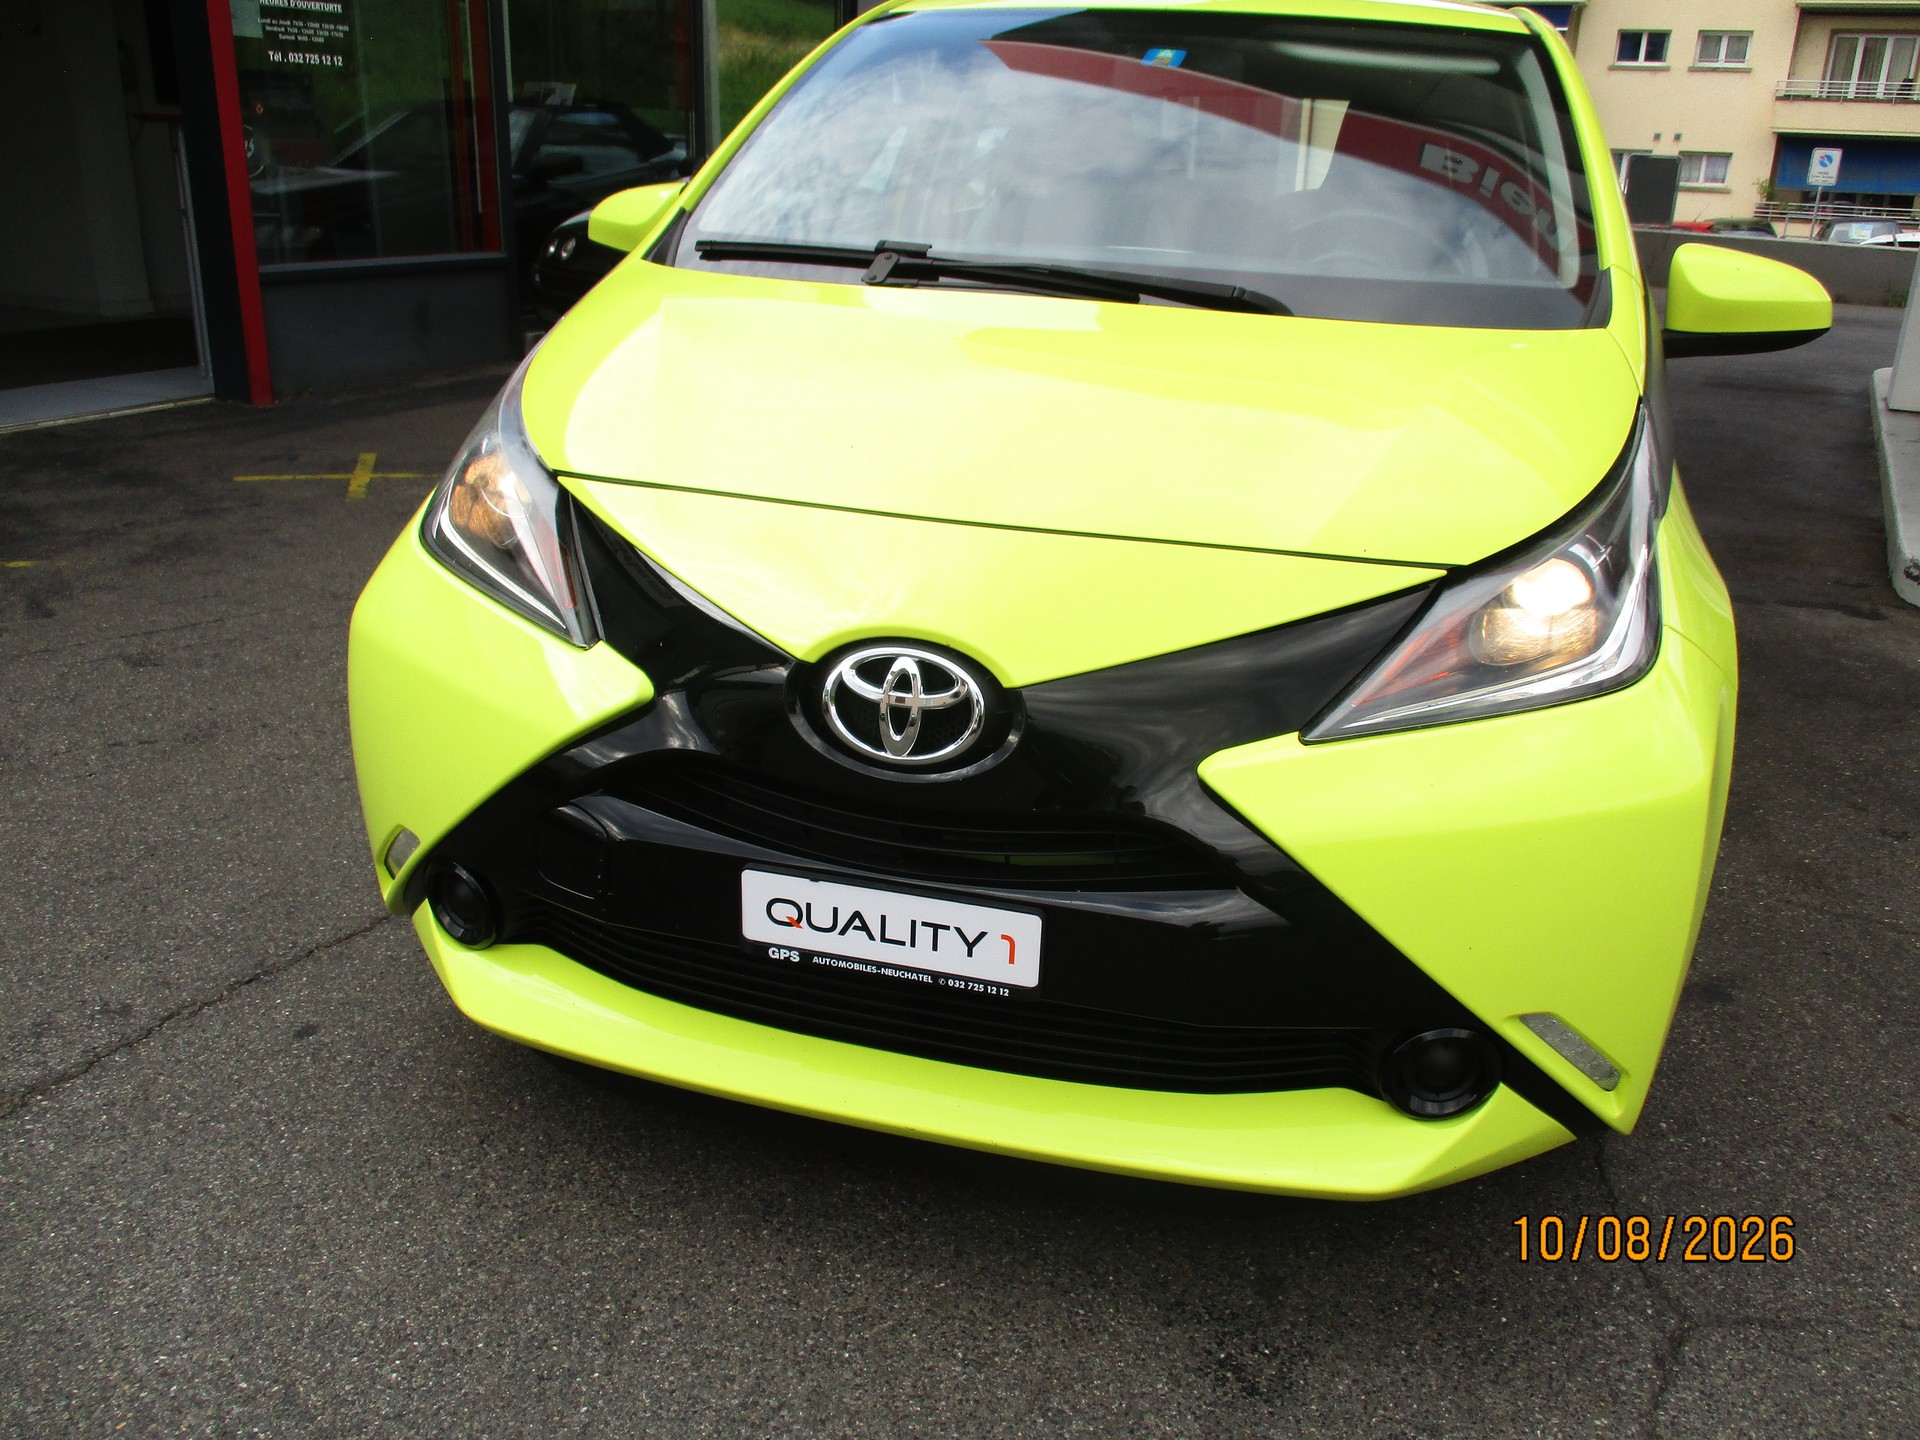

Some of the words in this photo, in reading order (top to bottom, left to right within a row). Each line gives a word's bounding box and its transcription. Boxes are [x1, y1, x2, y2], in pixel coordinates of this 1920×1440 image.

[288, 52, 304, 64] 032
[306, 53, 320, 65] 725
[321, 54, 332, 66] 12
[333, 55, 343, 67] 12
[765, 897, 988, 959] QUALITY
[768, 946, 801, 963] GPS
[812, 956, 933, 984] AUTOMOBILES-NEUCHATEL
[947, 978, 965, 990] 032
[967, 981, 985, 993] 725
[987, 984, 997, 995] 12
[999, 986, 1010, 997] 12
